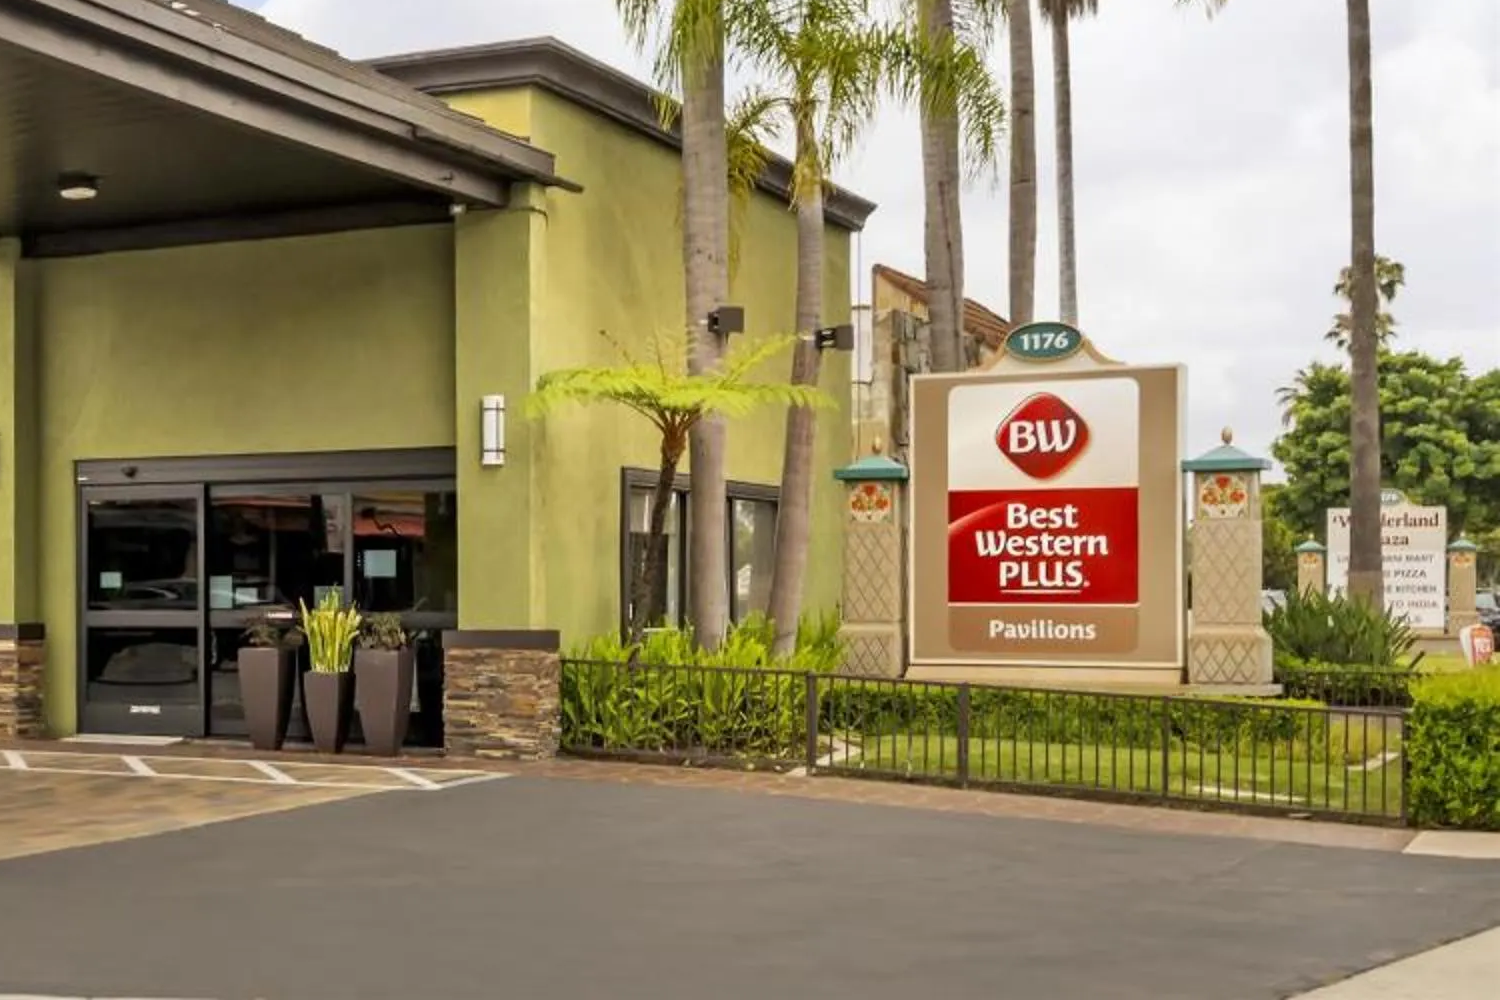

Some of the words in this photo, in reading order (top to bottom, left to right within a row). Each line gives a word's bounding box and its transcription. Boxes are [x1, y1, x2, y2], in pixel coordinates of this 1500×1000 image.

[1020, 331, 1069, 351] 1176
[1009, 419, 1077, 453] BW
[1007, 503, 1079, 529] Best
[975, 530, 1109, 557] Western
[1394, 569, 1427, 578] PIZZA
[1395, 584, 1437, 594] KITCHEN
[989, 619, 1097, 639] Pavilions
